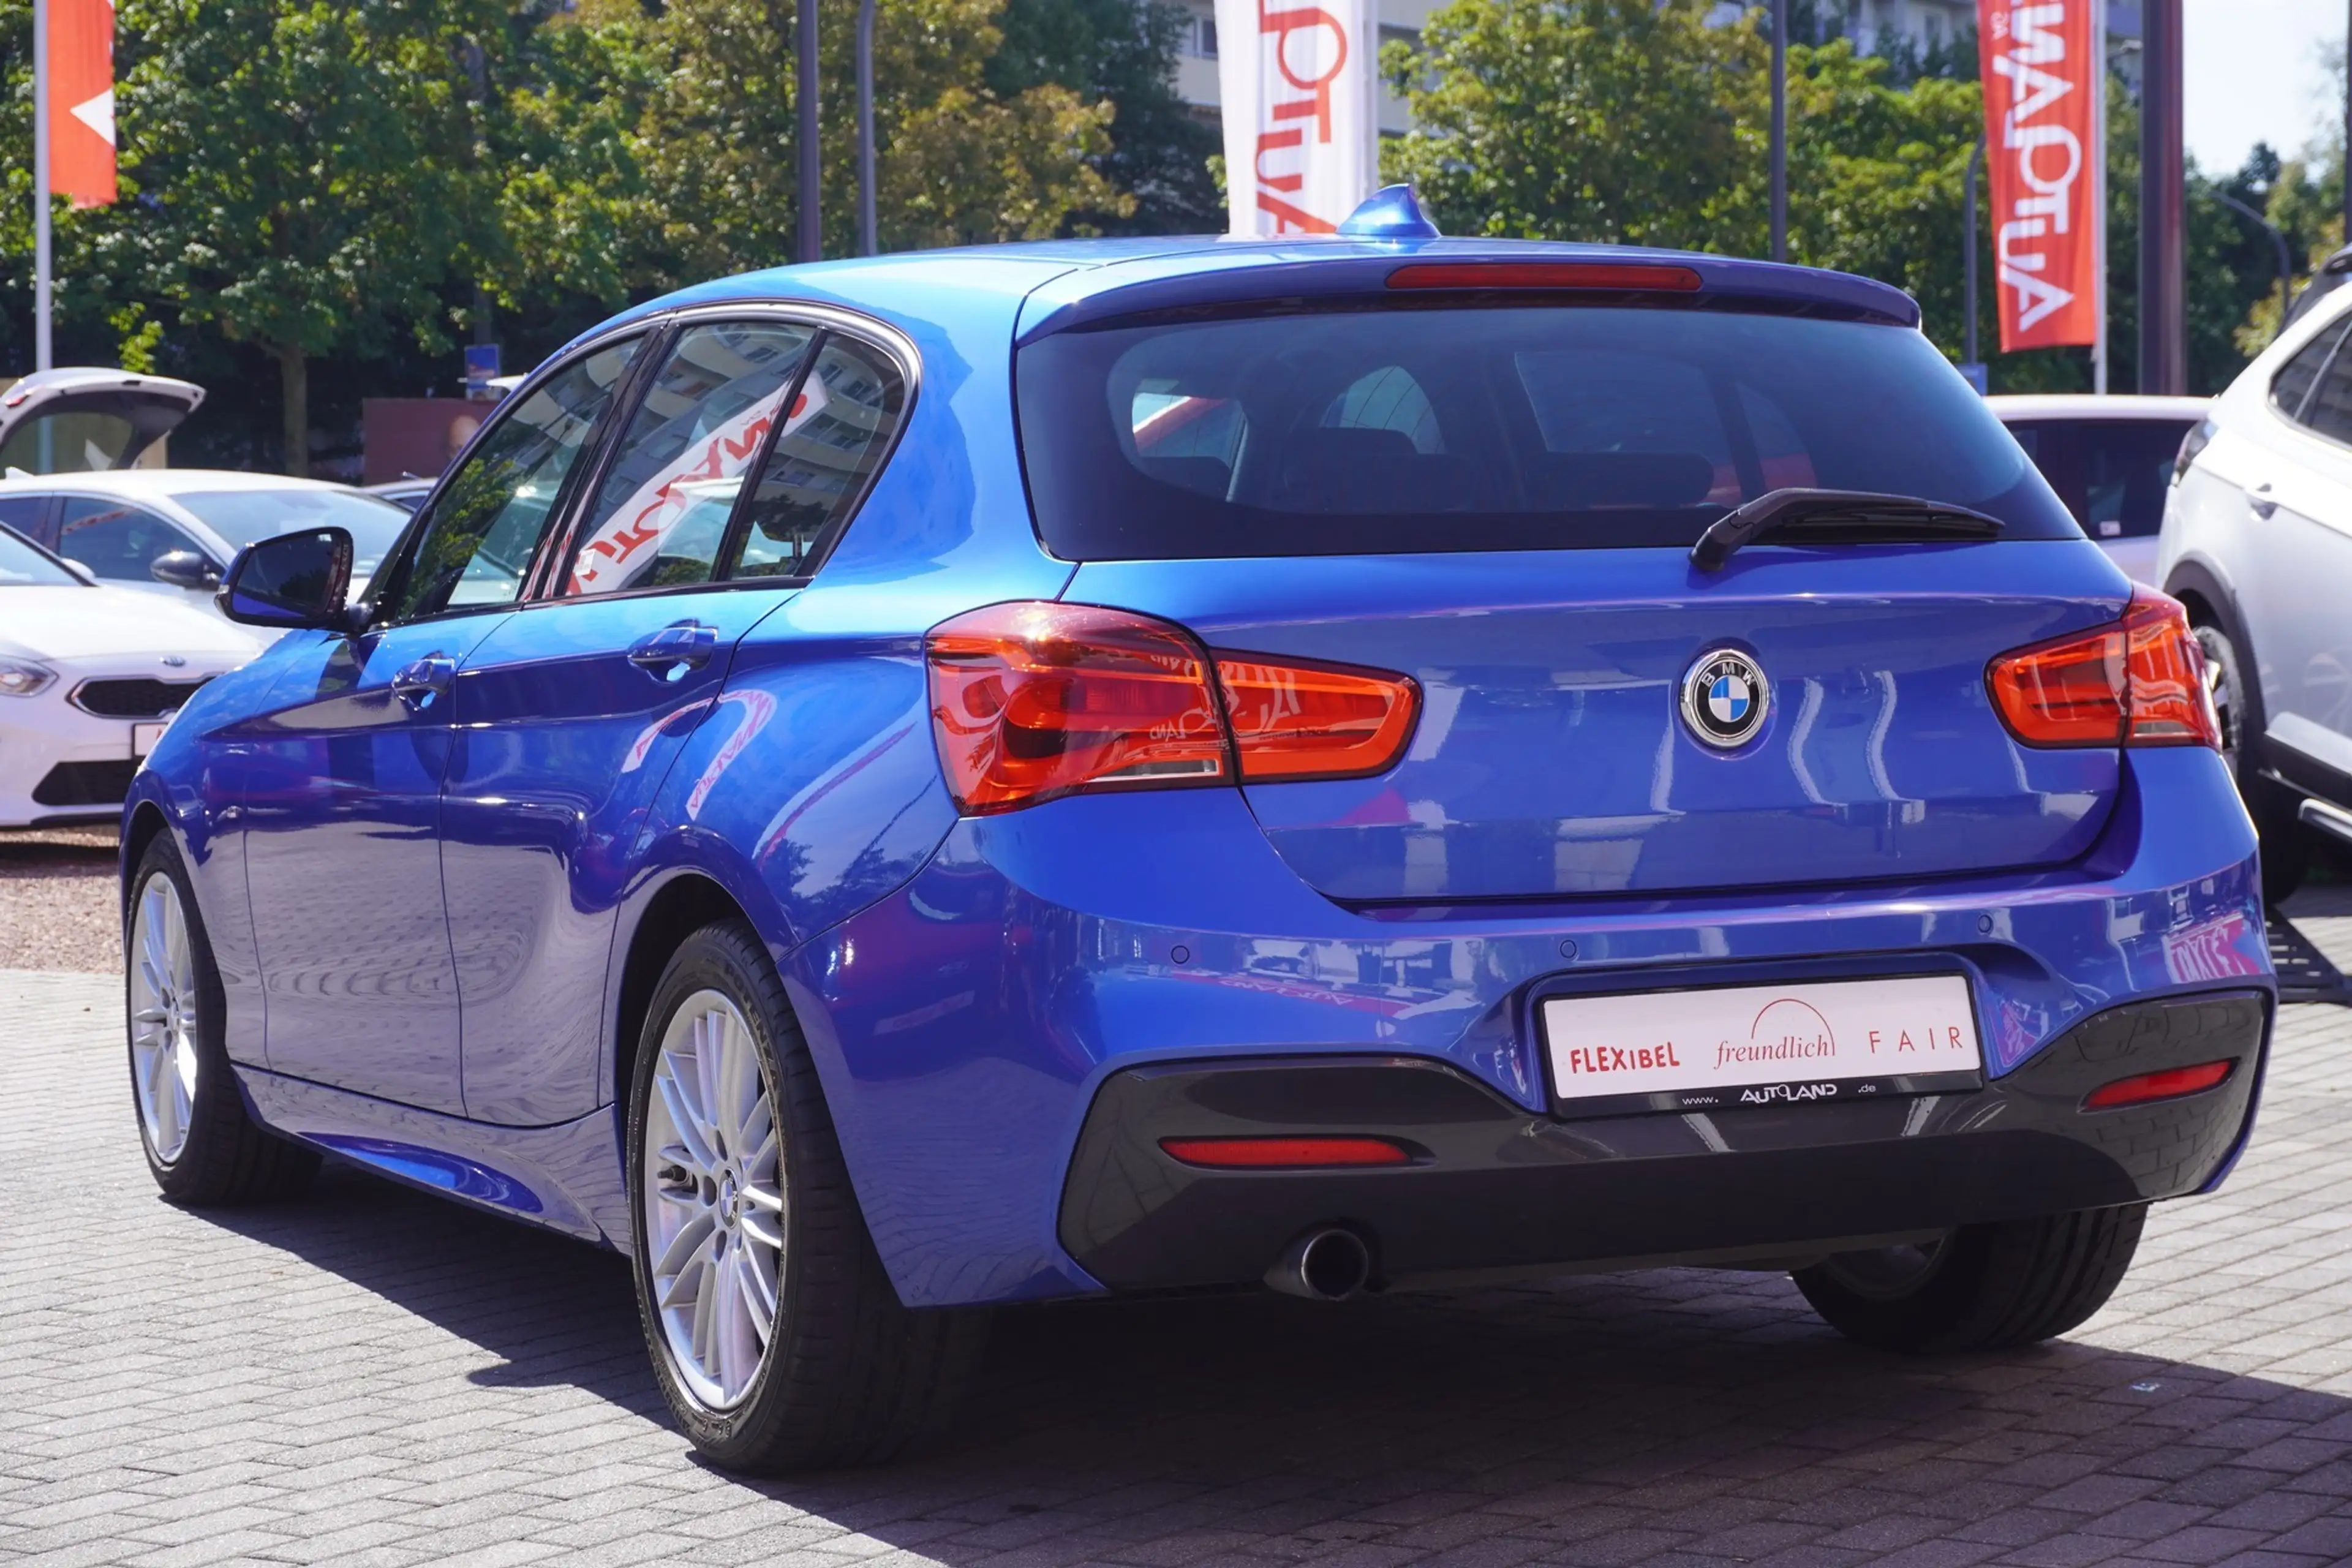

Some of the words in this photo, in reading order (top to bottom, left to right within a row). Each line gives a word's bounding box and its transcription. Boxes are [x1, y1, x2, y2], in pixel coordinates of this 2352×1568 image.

[1702, 662, 1756, 688] BMW
[1570, 1042, 1680, 1073] FLEXIBEL
[1714, 1034, 1836, 1070] freundlich
[1869, 1027, 1964, 1054] FAIR
[1682, 1096, 1719, 1105] www.
[1740, 1084, 1838, 1104] AUTOLAND
[1858, 1084, 1877, 1094] .de
